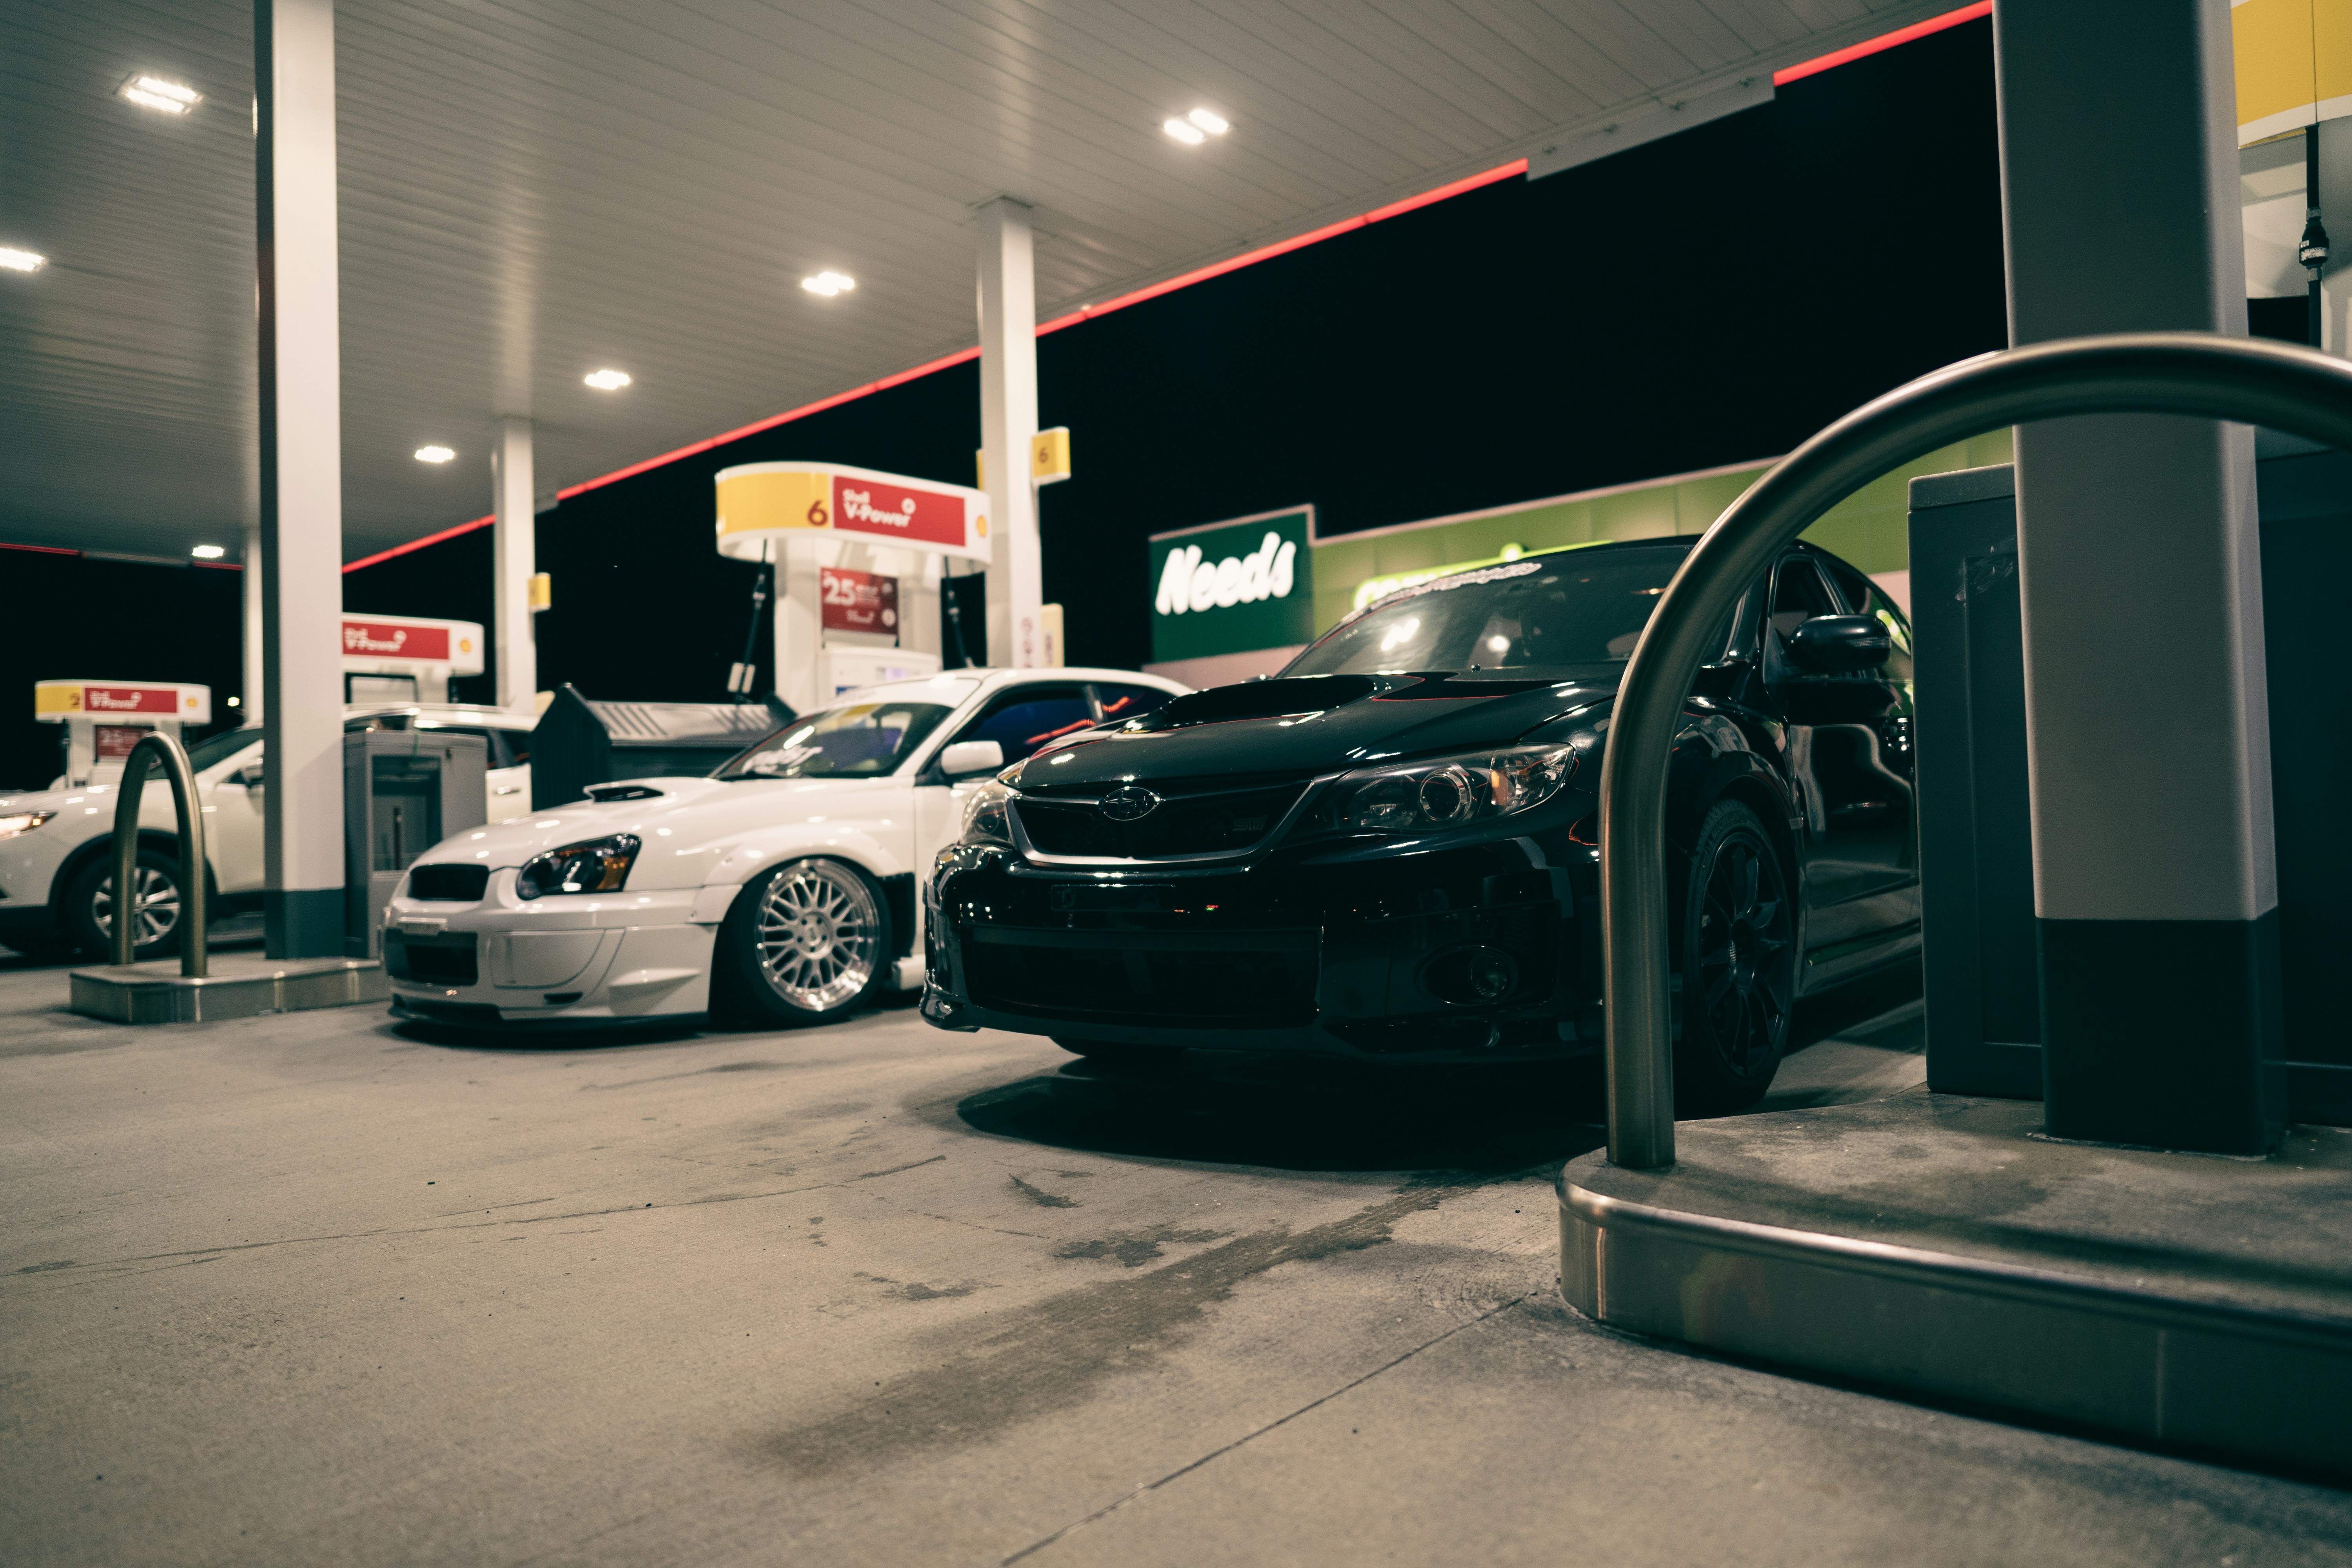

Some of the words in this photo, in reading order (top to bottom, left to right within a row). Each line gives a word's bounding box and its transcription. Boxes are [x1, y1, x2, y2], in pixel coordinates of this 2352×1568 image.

[1038, 446, 1049, 463] 6
[807, 499, 828, 526] 6
[1155, 532, 1296, 615] Needs
[823, 576, 856, 607] 25
[1711, 811, 1740, 840] MICHELIN
